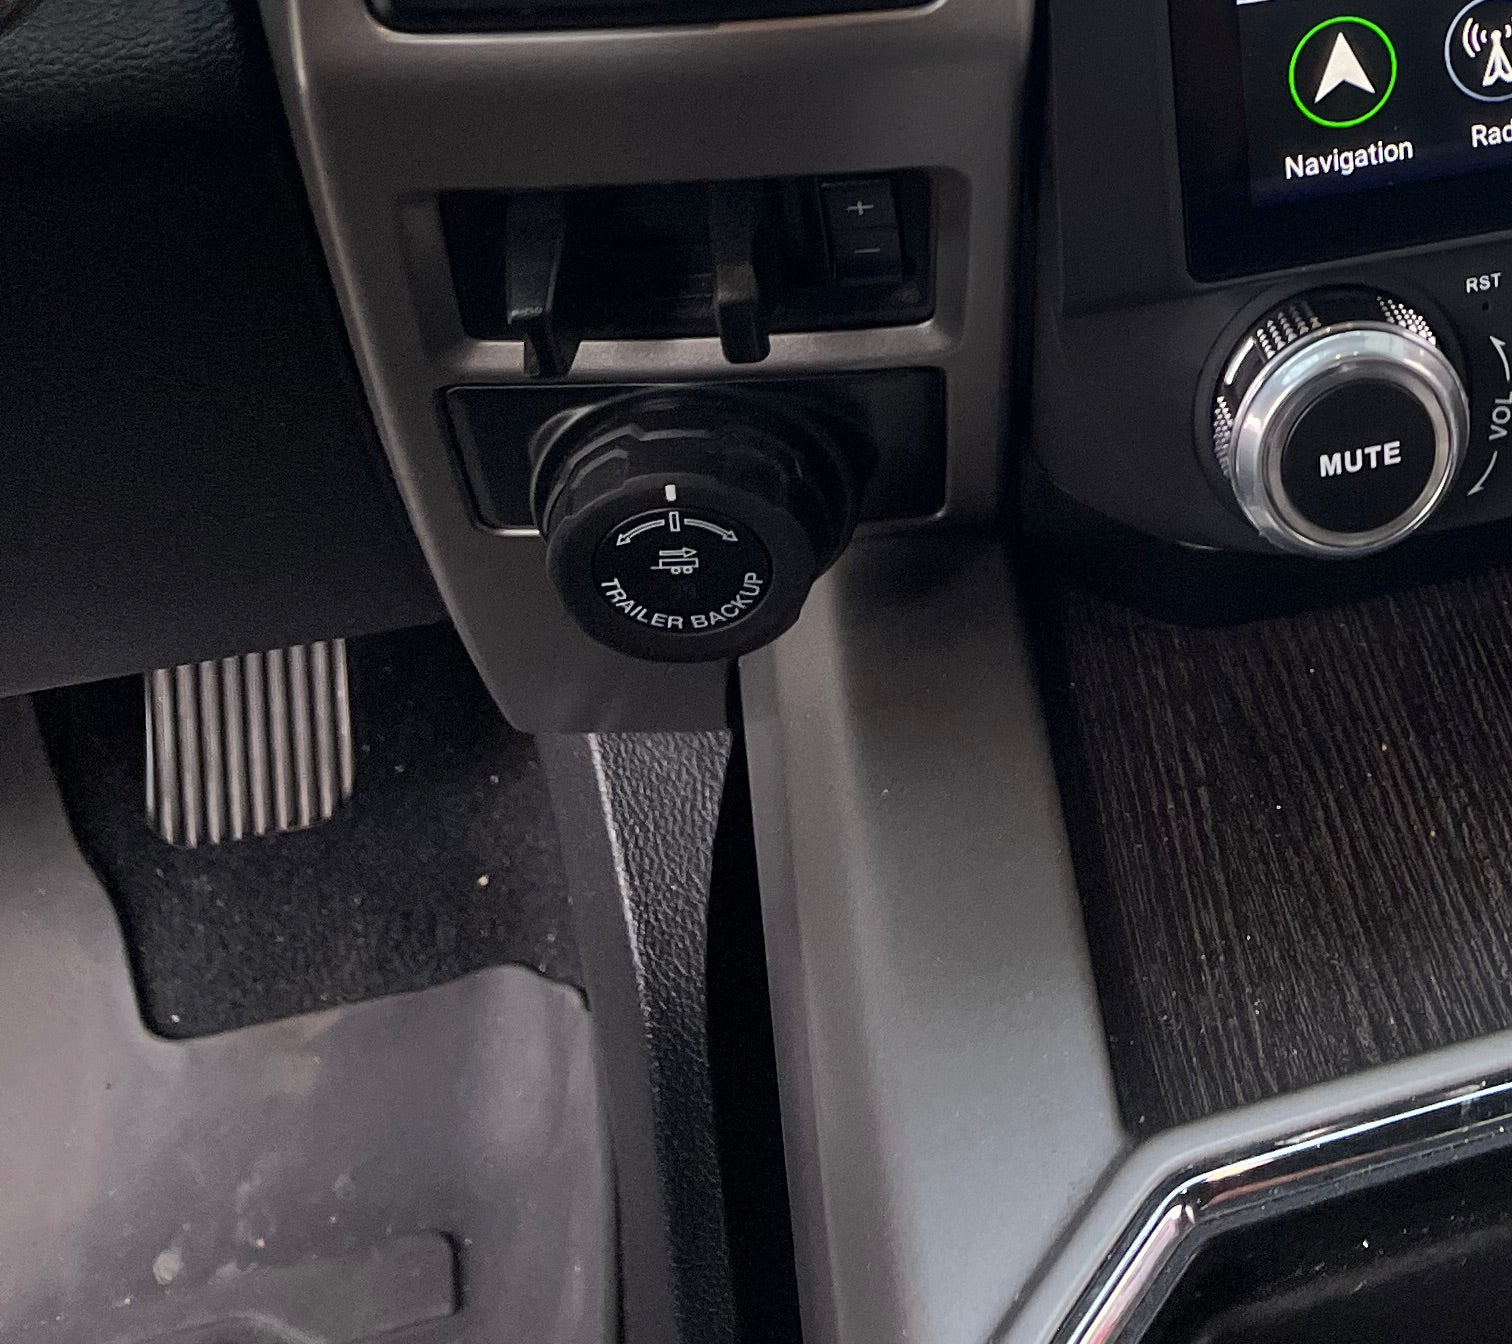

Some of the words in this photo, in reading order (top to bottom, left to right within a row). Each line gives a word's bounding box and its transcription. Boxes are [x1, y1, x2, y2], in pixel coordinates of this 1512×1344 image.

[1284, 138, 1414, 181] Navigation
[1464, 272, 1503, 295] RST
[1318, 439, 1402, 478] MUTE
[601, 576, 685, 631] TRAILER
[690, 570, 765, 630] BACKUP
